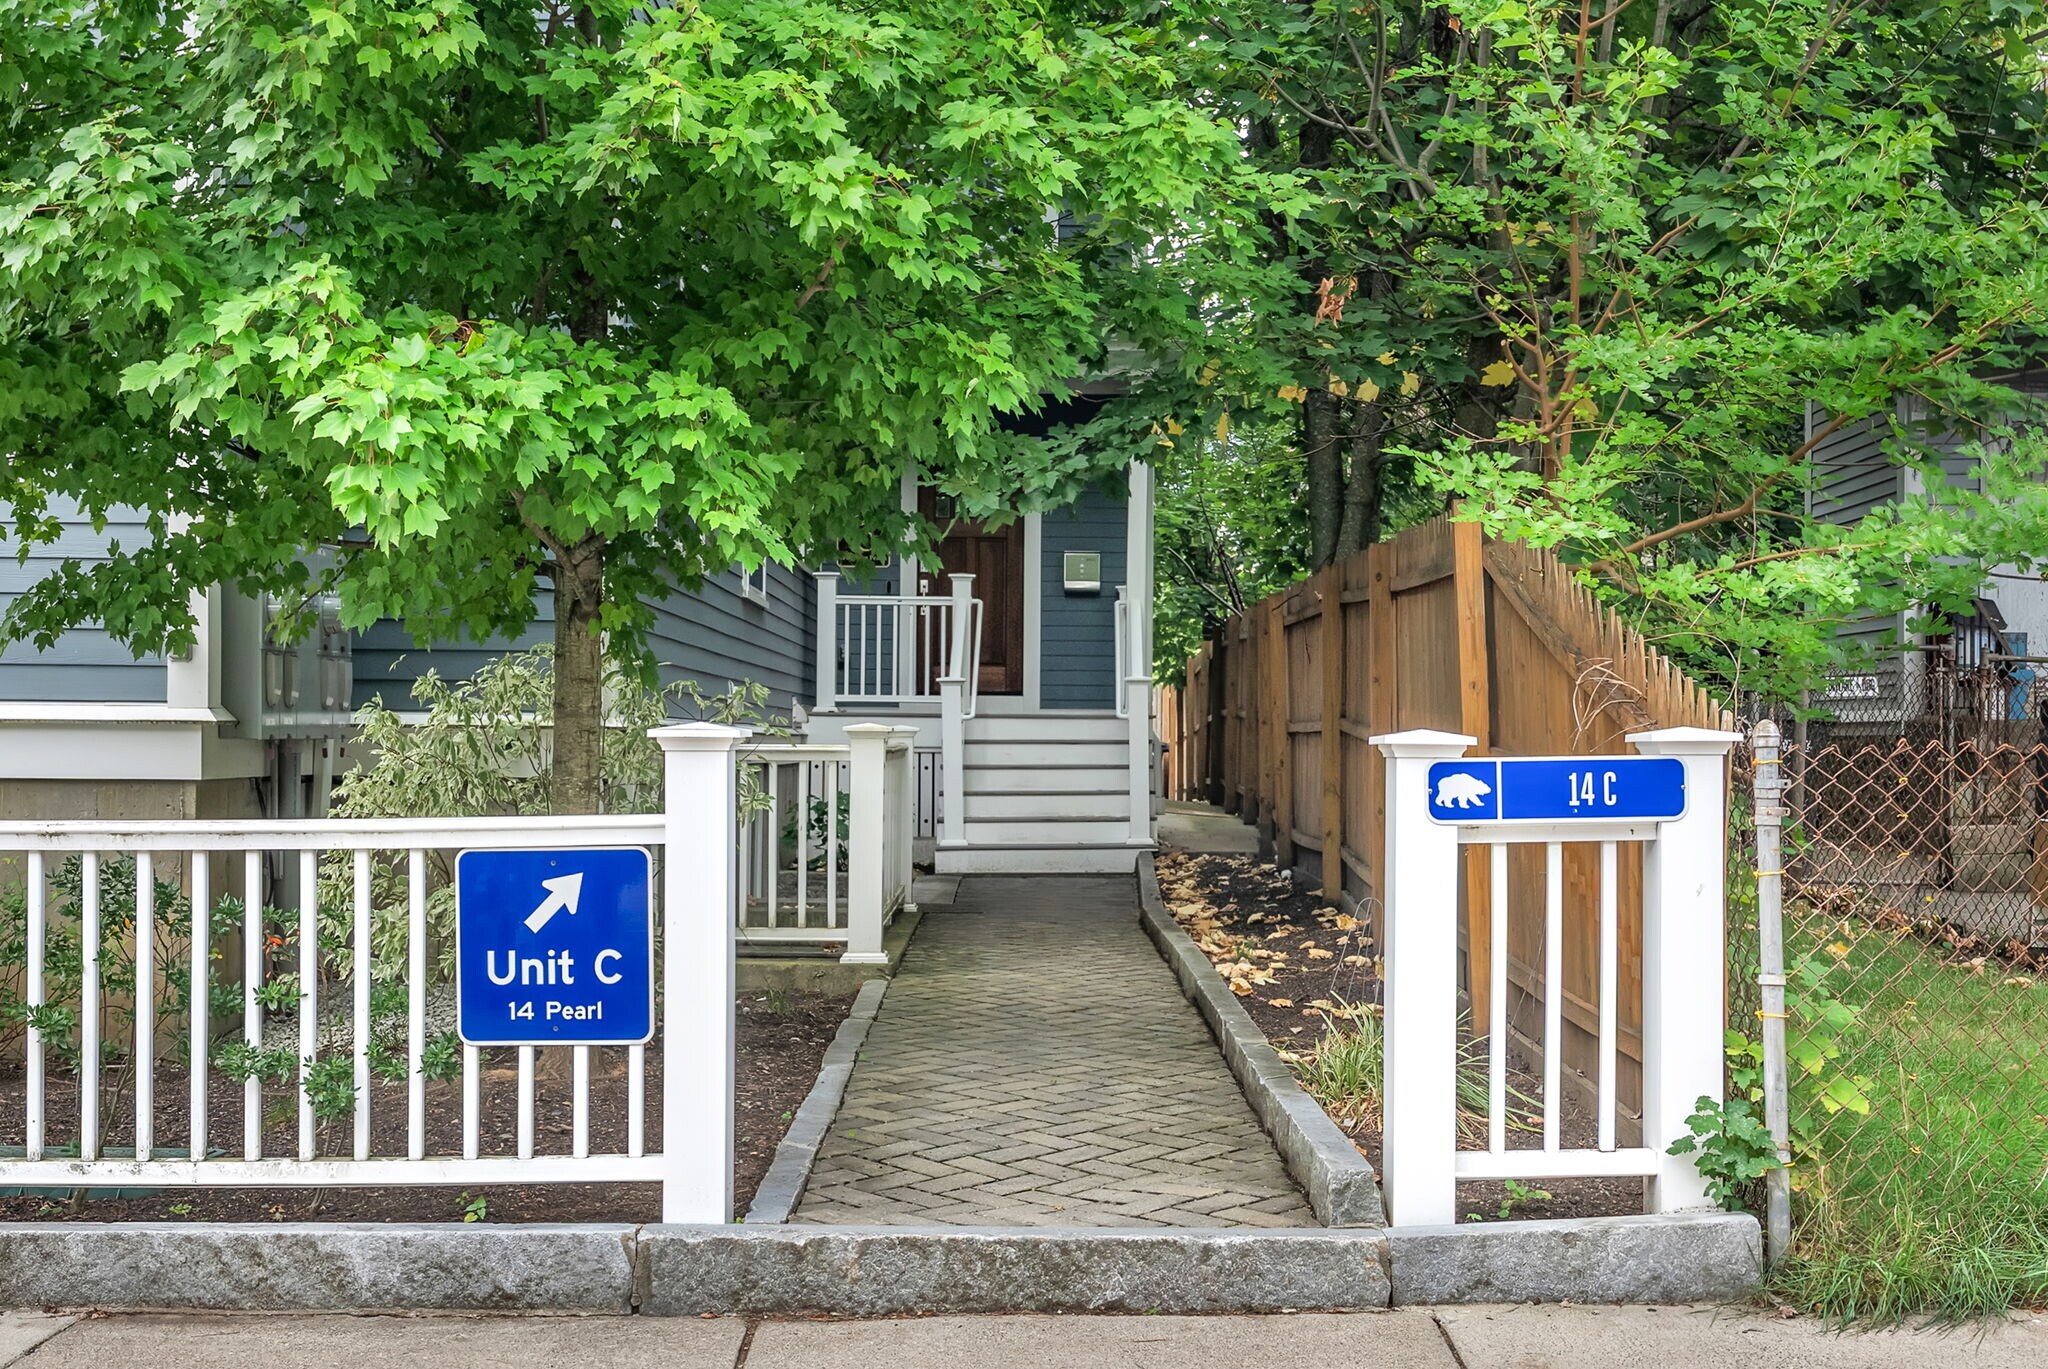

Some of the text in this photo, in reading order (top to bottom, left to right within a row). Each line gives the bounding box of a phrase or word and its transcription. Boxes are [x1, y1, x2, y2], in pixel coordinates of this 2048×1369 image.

[1568, 771, 1617, 806] 14 C
[487, 949, 623, 986] Unit C
[508, 1001, 602, 1020] 14 Pearl
